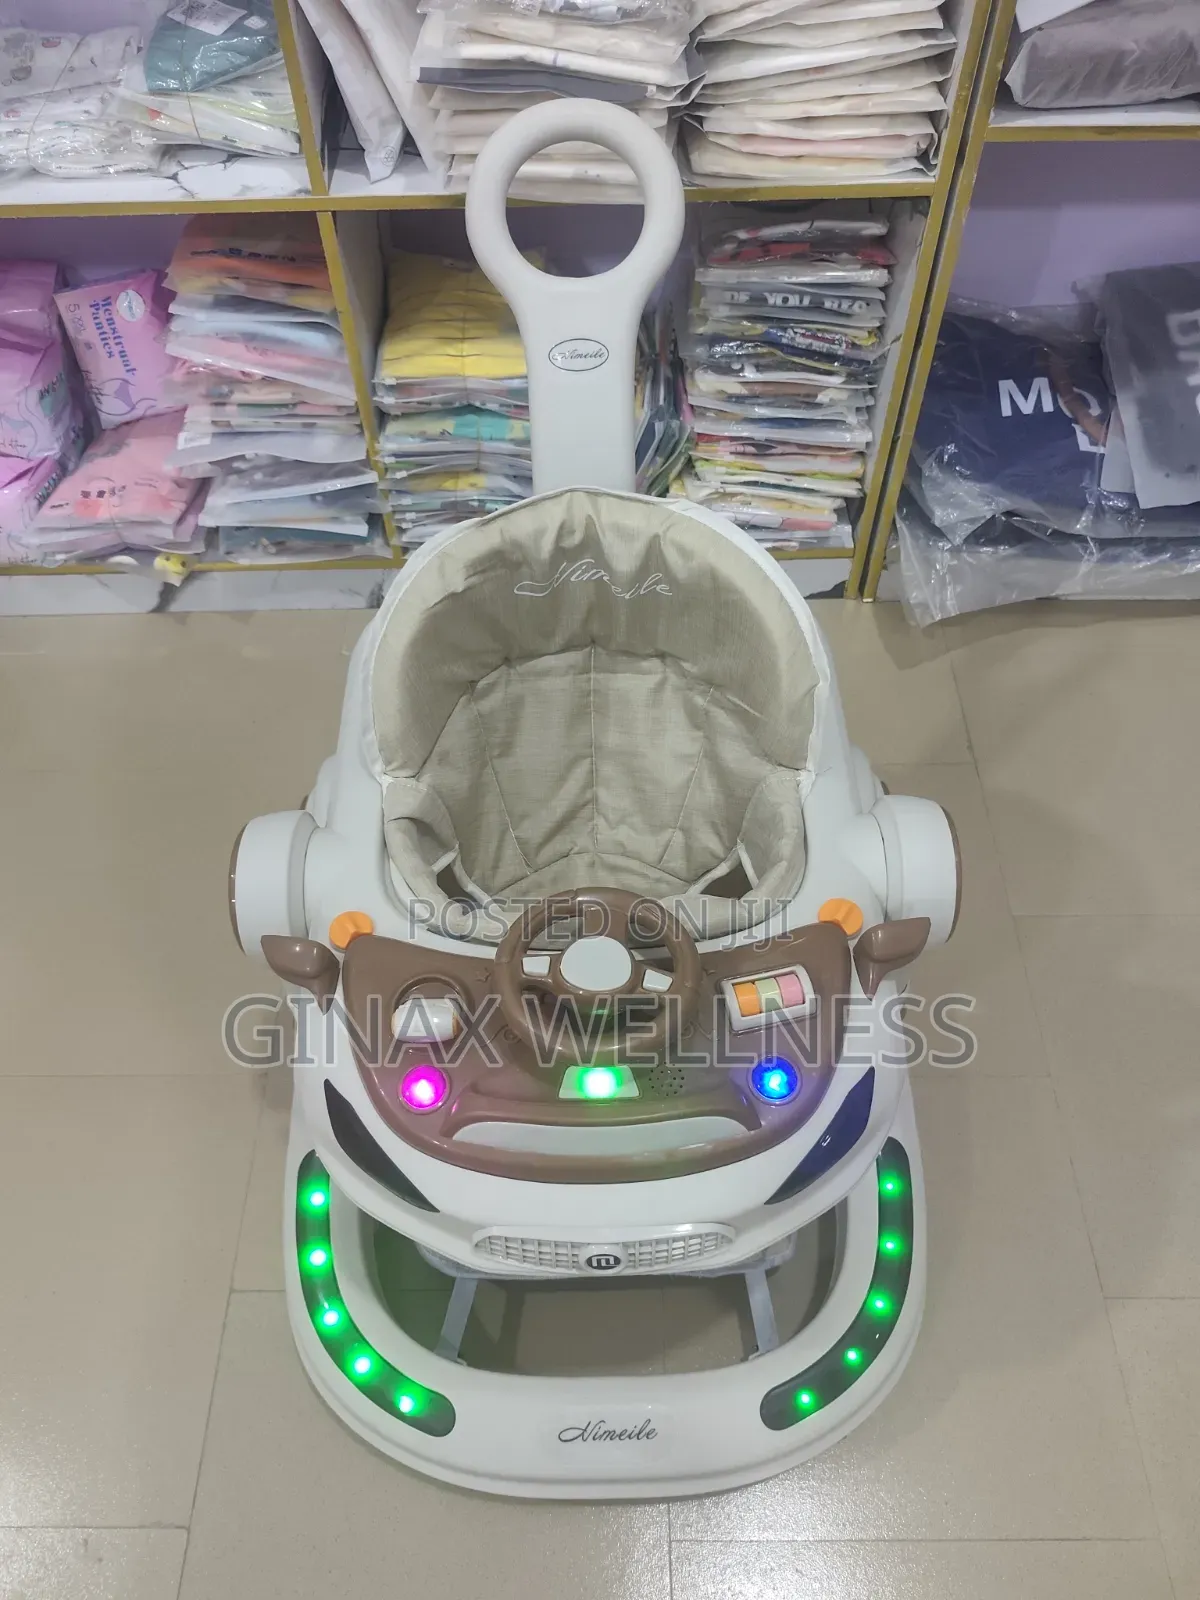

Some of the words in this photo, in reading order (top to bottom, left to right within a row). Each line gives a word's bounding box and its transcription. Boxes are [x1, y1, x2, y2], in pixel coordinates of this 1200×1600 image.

[762, 292, 812, 307] YOU
[89, 300, 116, 359] Panties
[101, 296, 138, 376] Menstrual
[551, 348, 607, 361] Nimeile
[557, 1418, 659, 1443] Nimeile
